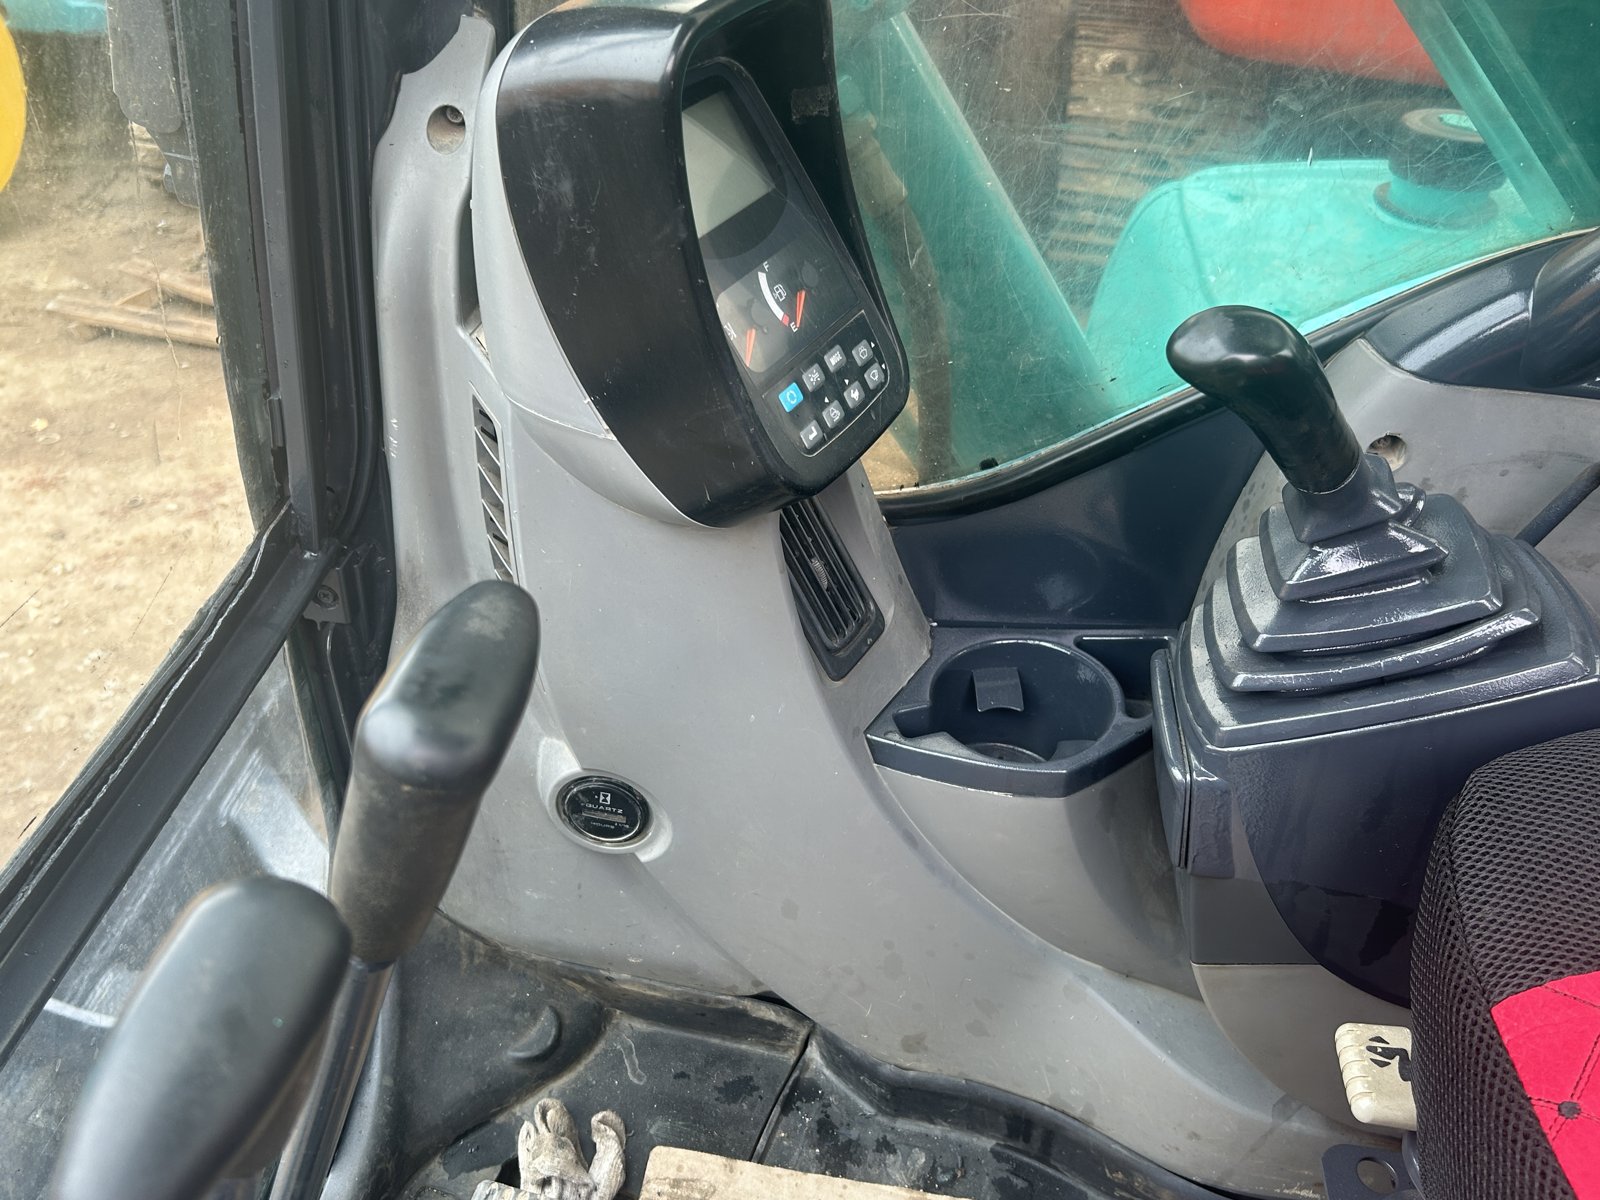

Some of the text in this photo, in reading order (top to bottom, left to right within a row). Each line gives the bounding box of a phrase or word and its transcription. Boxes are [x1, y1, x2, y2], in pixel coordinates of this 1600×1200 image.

[763, 261, 770, 272] F
[790, 321, 798, 333] E
[585, 803, 624, 814] QUARTZ
